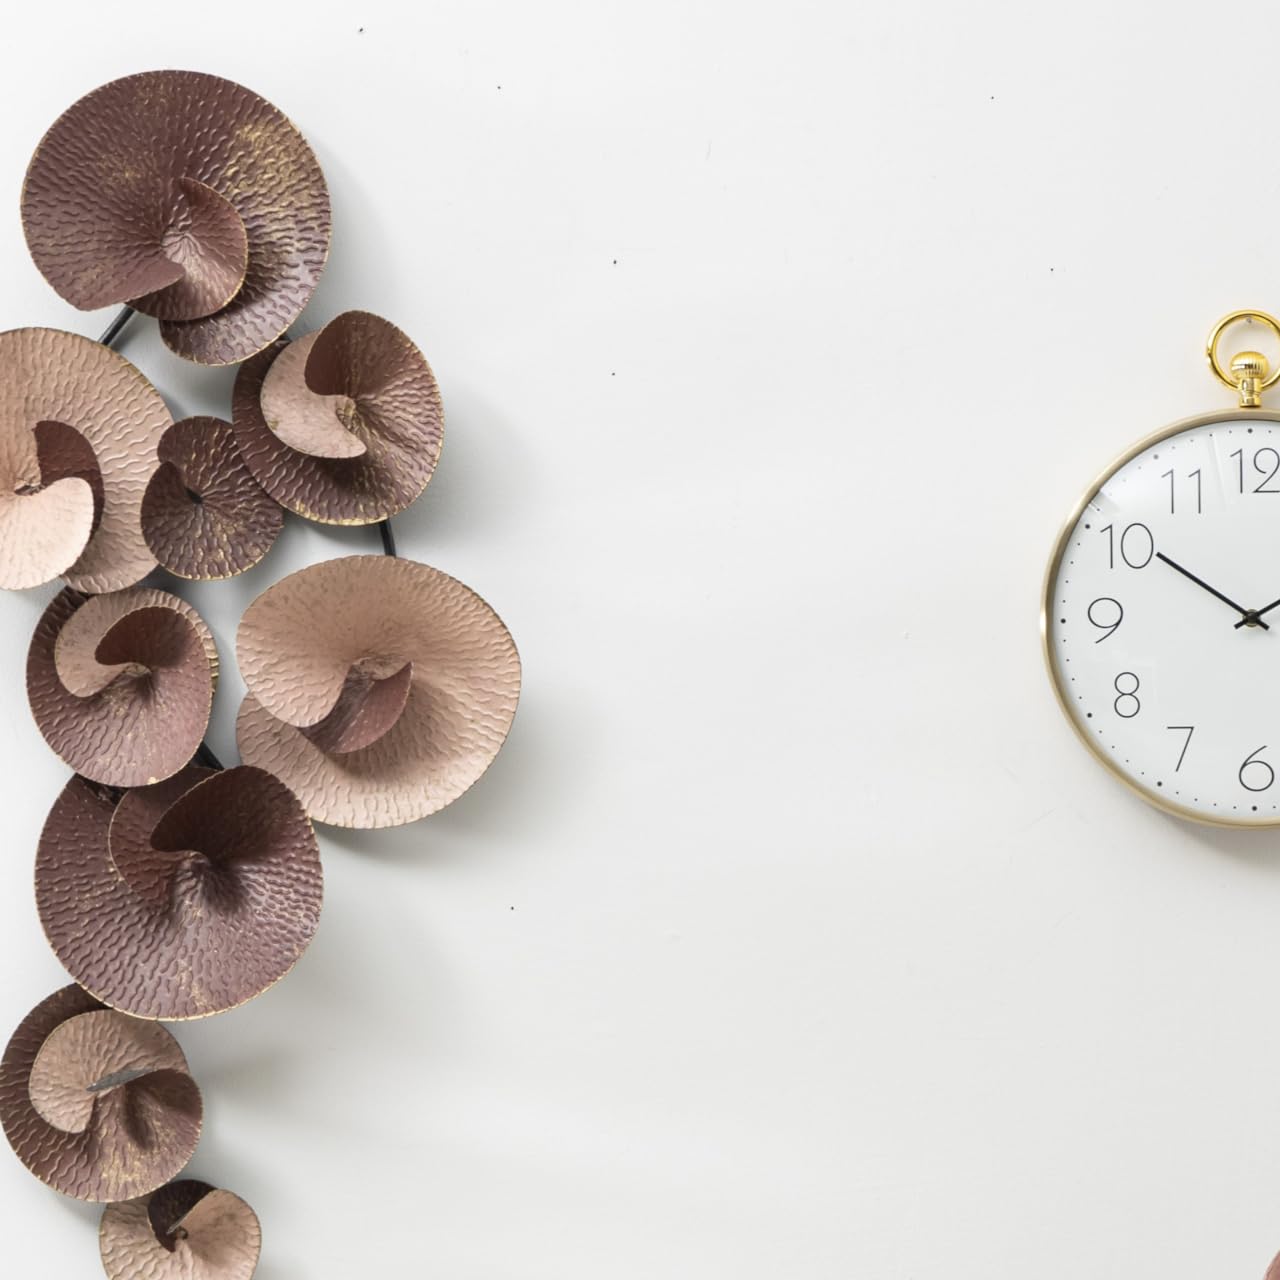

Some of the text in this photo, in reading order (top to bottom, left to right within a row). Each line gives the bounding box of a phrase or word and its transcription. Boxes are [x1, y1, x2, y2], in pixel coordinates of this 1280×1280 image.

[1161, 468, 1202, 515] 11
[1229, 447, 1280, 494] 12
[1099, 523, 1154, 570] 10
[1087, 597, 1124, 644] 9
[1114, 671, 1141, 718] 8
[1166, 726, 1195, 773] 7
[1238, 745, 1275, 792] 6
